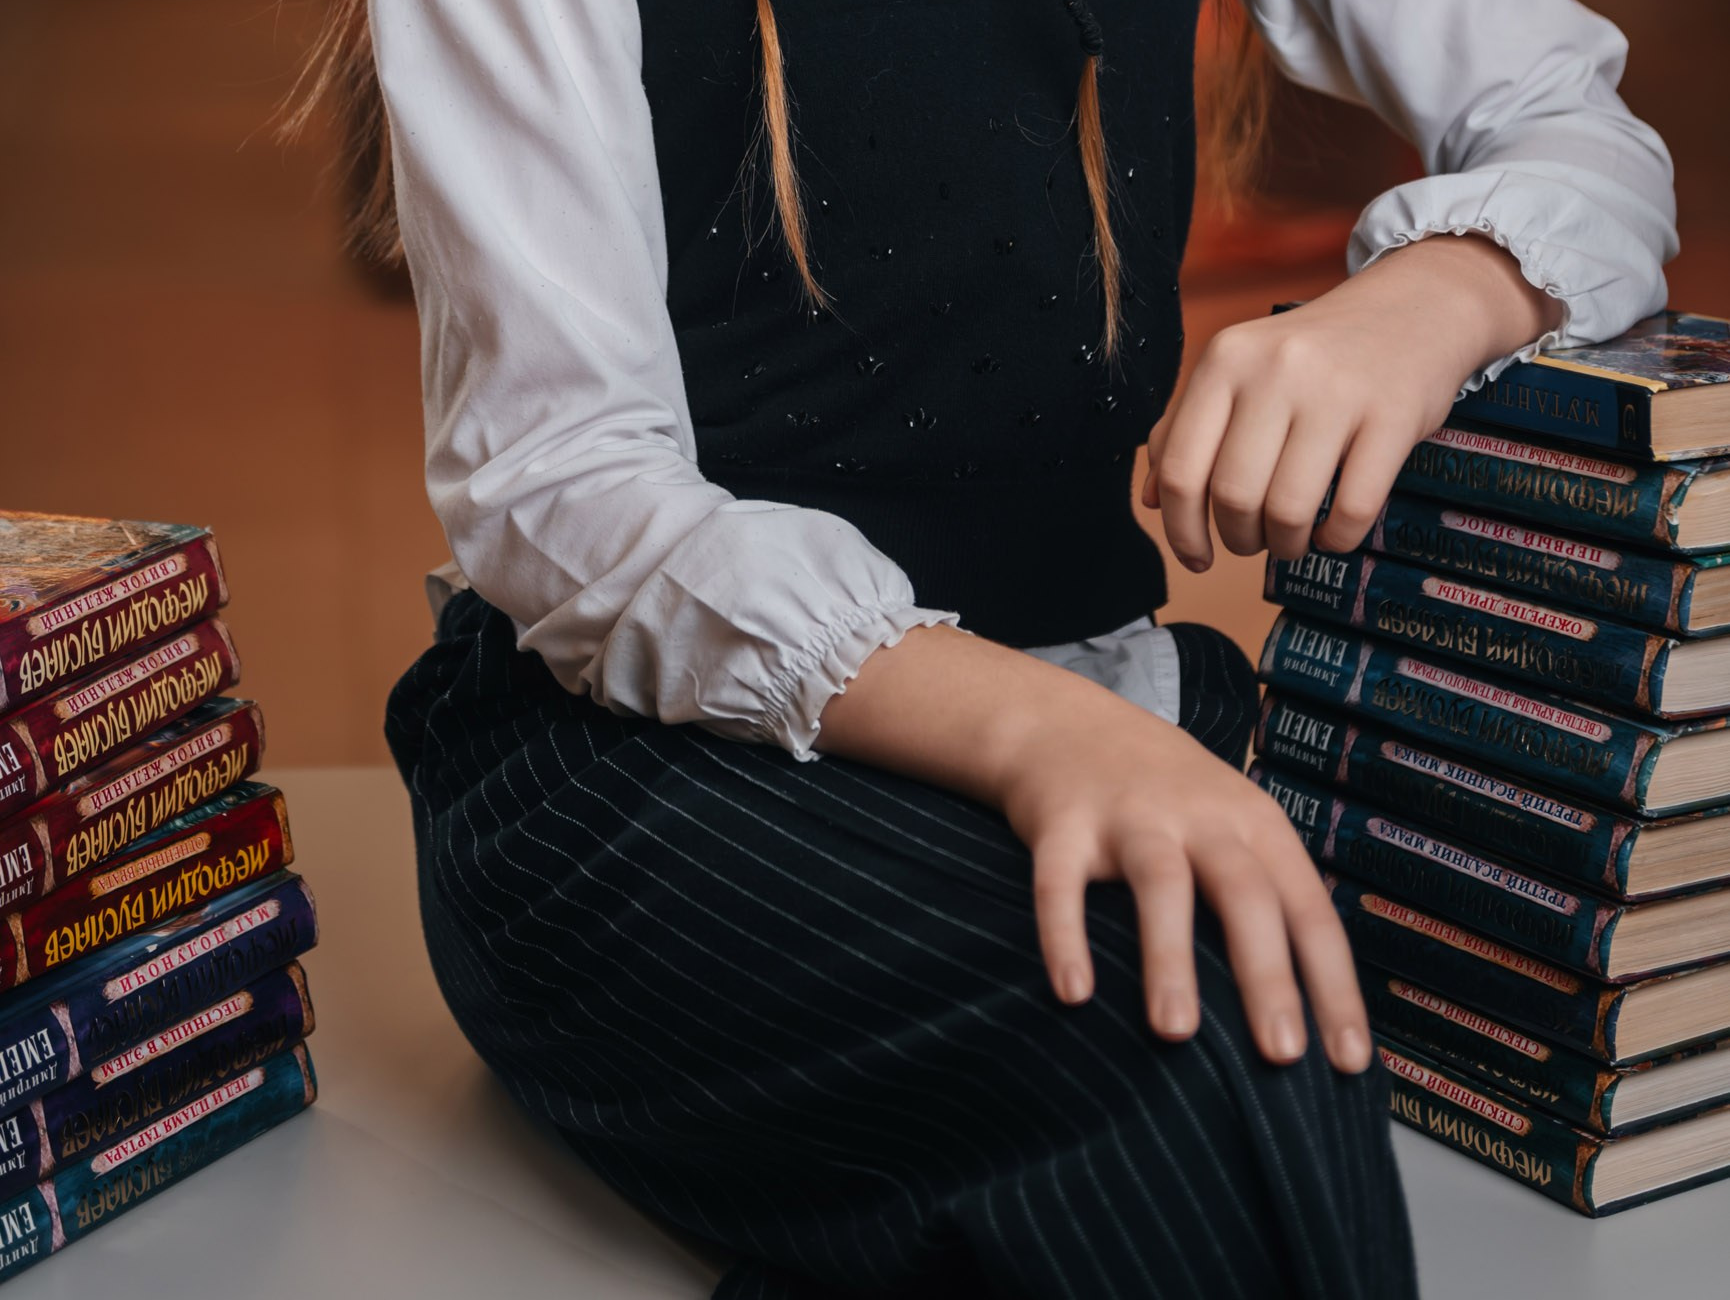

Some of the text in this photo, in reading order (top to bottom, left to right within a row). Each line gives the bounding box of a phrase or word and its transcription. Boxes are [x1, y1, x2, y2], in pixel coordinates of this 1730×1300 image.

[1456, 432, 1506, 454] ТЕМНОГО
[1507, 441, 1530, 460] ДЛЯ
[1526, 445, 1573, 468] КРЫЛЬЯ
[1573, 455, 1626, 481] СВЕТЛЫЕ
[1497, 457, 1639, 519] МЕФОДИЙ
[1456, 514, 1602, 562] ПЕРВЫЙ ЭЙДОС
[39, 558, 179, 631] СВИТОК ЖЕЛАНИЙ
[1283, 580, 1342, 610] Дмитрий
[1437, 584, 1582, 635] ОЖЕРЕЛЬЕ ДРИАДЫ
[19, 572, 209, 695] МЕФОДИЙ БУСЛАЕВ
[1286, 622, 1349, 668] ЕМЕЦ
[1377, 598, 1478, 655] БУСЛАЕВ
[66, 637, 191, 714] СВИТОК ЖЕЛАНИЙ
[1282, 655, 1341, 688] Дмитрий
[1406, 659, 1602, 737] СВЕТЛЫЕ КРЫЛЬЯ ДЛЯ ТЕМНОГО СТРАЖА
[53, 651, 223, 777] МЕФОДИЙ БУСЛАЕВ
[1275, 703, 1335, 752] ЕМЕЦ
[90, 728, 223, 811] СВИТОК ЖЕЛАНИЙ
[1272, 739, 1328, 772] Дмитрий
[65, 742, 248, 877] МЕФОДИЙ БУСЛАЕВ
[1393, 743, 1583, 827] ТРЕТИЙ ВСАДНИК МРАКА
[97, 836, 205, 891] ОГНЕННЫЕ ВРАТА
[1379, 821, 1567, 910] ТРЕТИЙ ВСАДНИК МРАКА
[44, 837, 270, 968] МЕФОДИЙ БУСЛАЕВ
[119, 905, 271, 994] МАГ ПОЛУНОЧИ
[1370, 896, 1573, 990] ТАЙНАЯ МАГИЯ ДЕПРЕСНЯКА
[1397, 982, 1443, 1012] СТРАЖ
[100, 997, 242, 1077] ЛЕСТНИЦА В ЭДЕМ
[1445, 1001, 1541, 1057] СТЕКЛЯННЫЙ
[211, 1090, 222, 1105] И
[223, 1074, 250, 1095] ЛЕД
[1426, 1074, 1525, 1133] СТЕКЛЯННЫЙ
[162, 1098, 210, 1130] ПЛАМЯ
[104, 1126, 162, 1164] ТАРТАРА
[1426, 1104, 1553, 1187] МЕФОДИЙ
